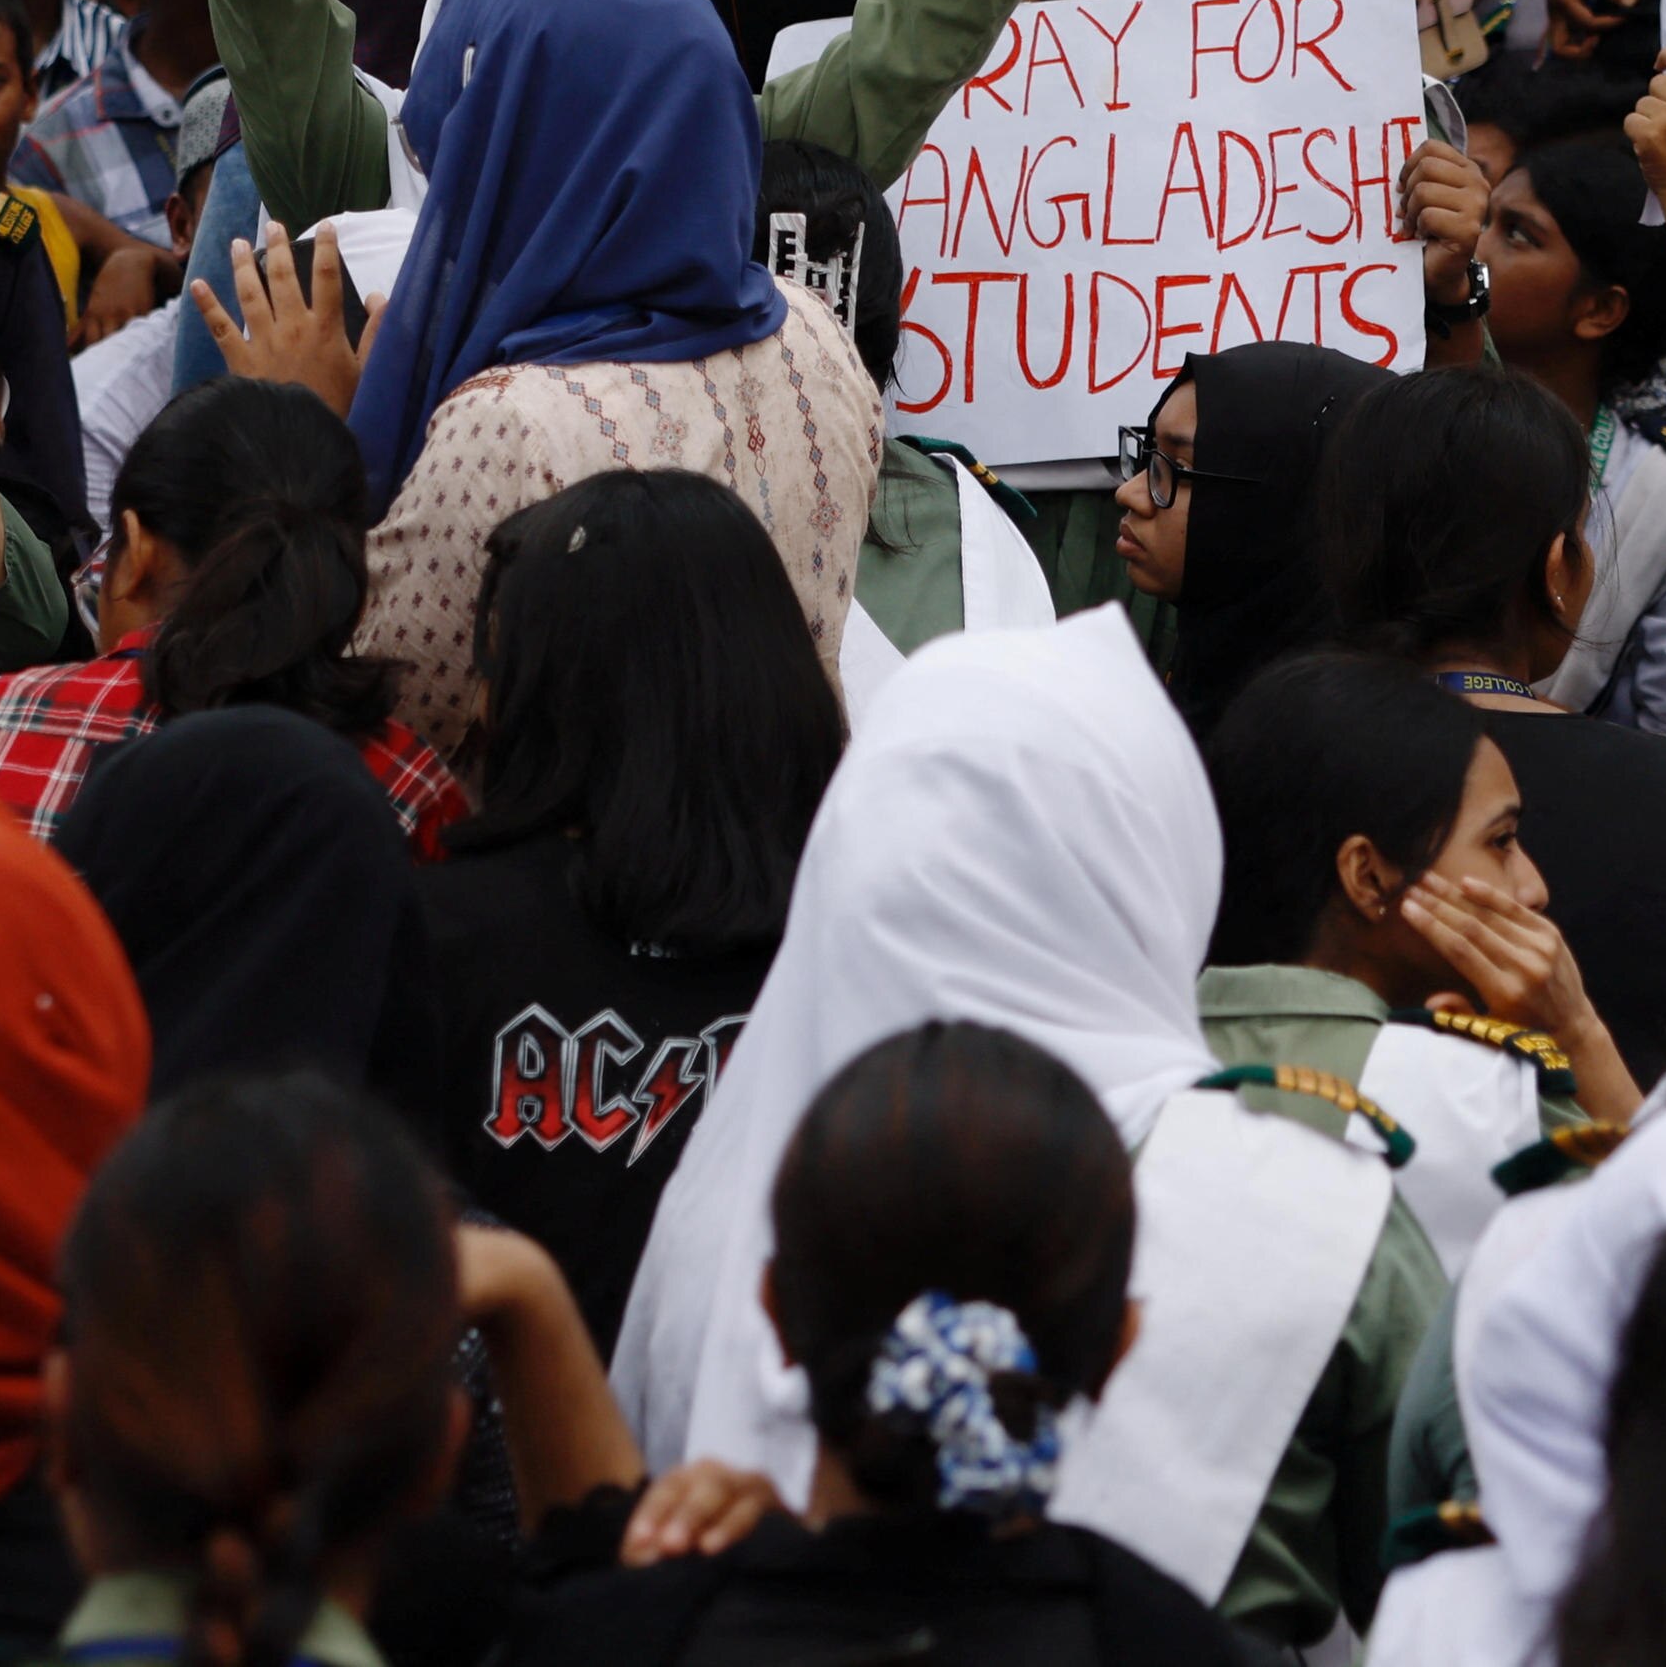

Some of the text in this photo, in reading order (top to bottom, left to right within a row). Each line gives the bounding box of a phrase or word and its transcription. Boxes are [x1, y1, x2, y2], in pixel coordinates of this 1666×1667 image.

[962, 0, 1144, 120] RAY
[895, 115, 1424, 260] ANGLADESHI
[894, 261, 1400, 415] STUDENTS
[1463, 675, 1525, 694] COLLEGE
